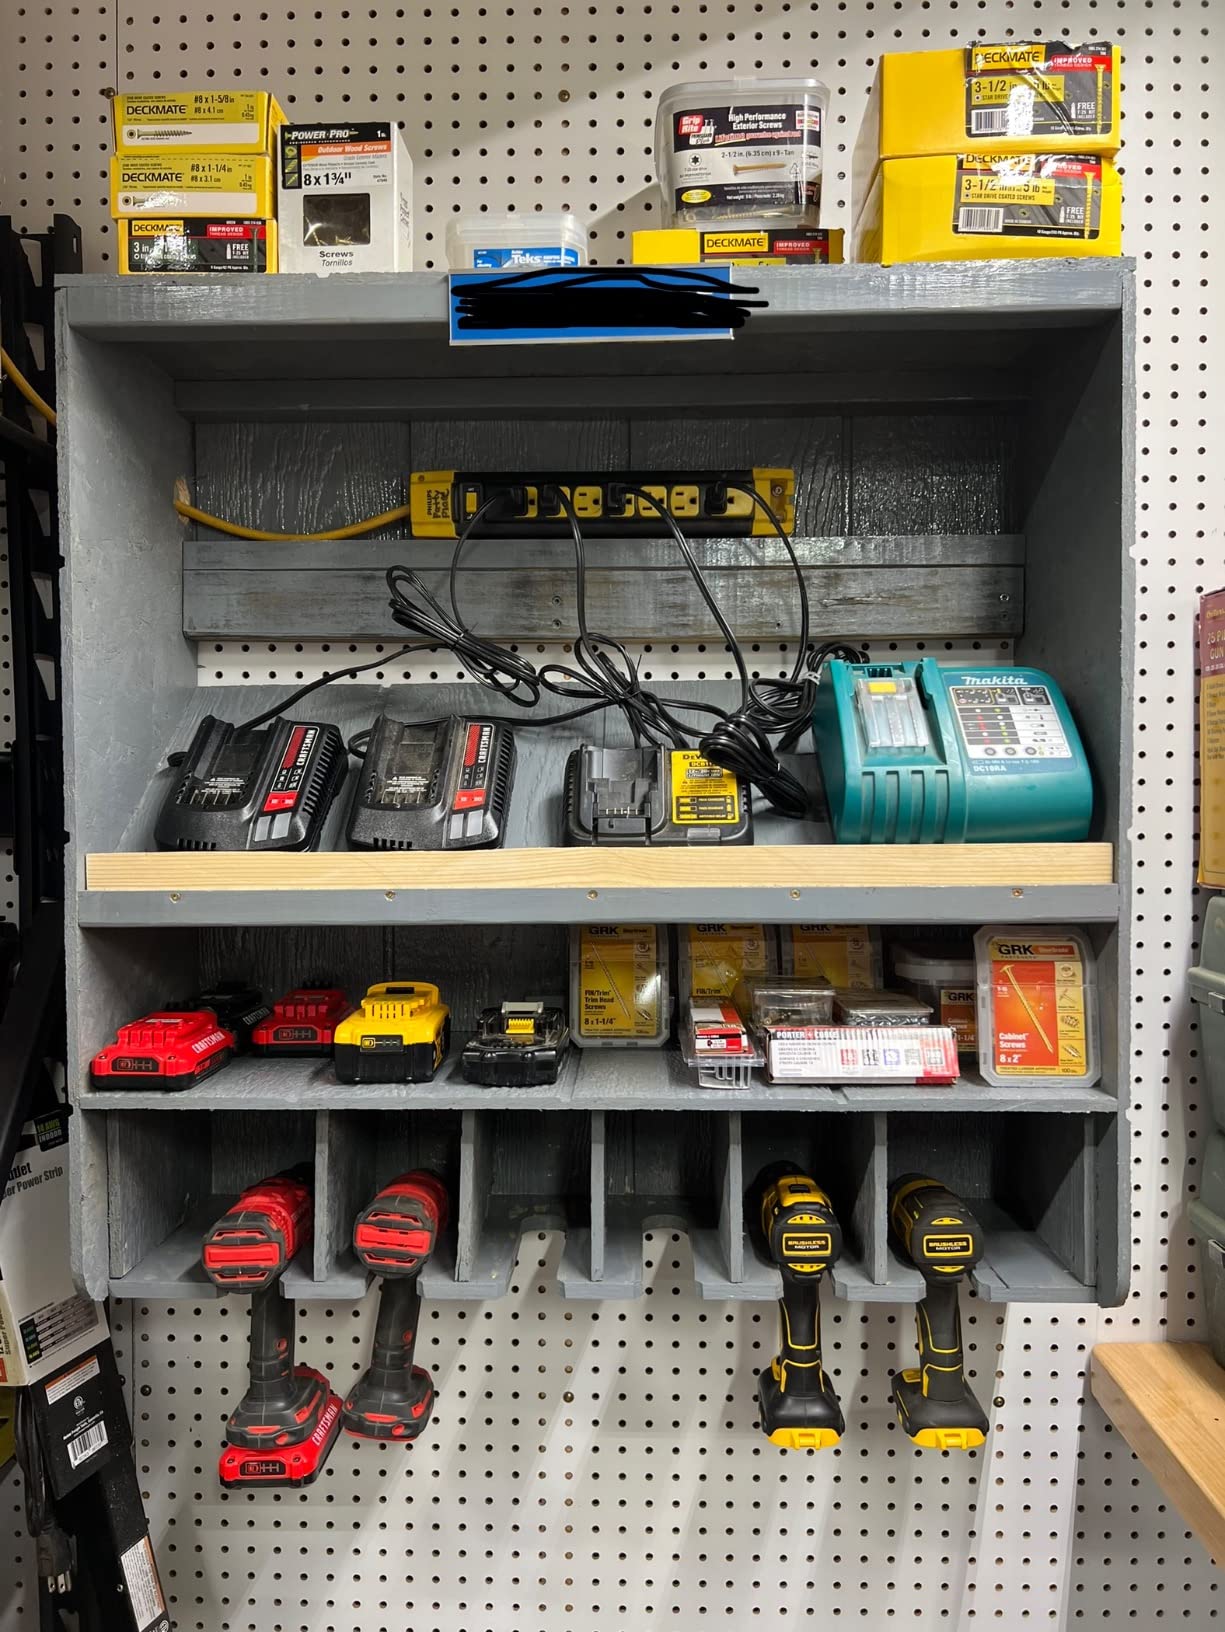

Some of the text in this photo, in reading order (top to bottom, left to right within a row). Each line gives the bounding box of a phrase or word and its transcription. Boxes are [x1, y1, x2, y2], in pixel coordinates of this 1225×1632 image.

[975, 80, 1006, 92] 3-1/2
[194, 94, 202, 104] #8
[211, 94, 229, 103] 1-5/8
[126, 104, 186, 115] DECKMATE
[1077, 102, 1096, 110] FREE
[728, 114, 743, 122] High
[744, 112, 786, 121] Performance
[732, 121, 782, 130] Exterior Screws
[291, 130, 326, 140] POWER
[329, 130, 350, 138] PRO
[966, 154, 1032, 164] DECKM
[191, 164, 200, 173] #8
[208, 164, 226, 172] 1-1/4
[122, 172, 182, 182] DECKMATE
[304, 174, 312, 186] 8
[313, 176, 321, 185] x
[964, 178, 996, 191] 3-1/2
[1066, 206, 1084, 214] FREE
[134, 224, 182, 232] DECKMA
[134, 242, 140, 252] 3
[706, 238, 763, 248] DECKMATE
[319, 250, 354, 258] Screws
[512, 253, 542, 264] Teks
[296, 728, 316, 766] CRAFTSMAN
[478, 727, 491, 764] CRAFTSMAN
[590, 926, 619, 935] GRK
[998, 944, 1034, 955] GRK
[776, 1031, 805, 1039] PORTER
[999, 1032, 1025, 1040] Cabinet
[191, 1031, 226, 1054] CRAFTSMAN
[999, 1040, 1026, 1048] Screws
[1000, 1054, 1006, 1063] 8
[39, 1129, 62, 1142] INDOOR
[8, 1162, 32, 1181] utlet
[16, 1174, 42, 1192] Power
[44, 1166, 64, 1181] Strip
[311, 1403, 338, 1446] CRAFTSMAN
